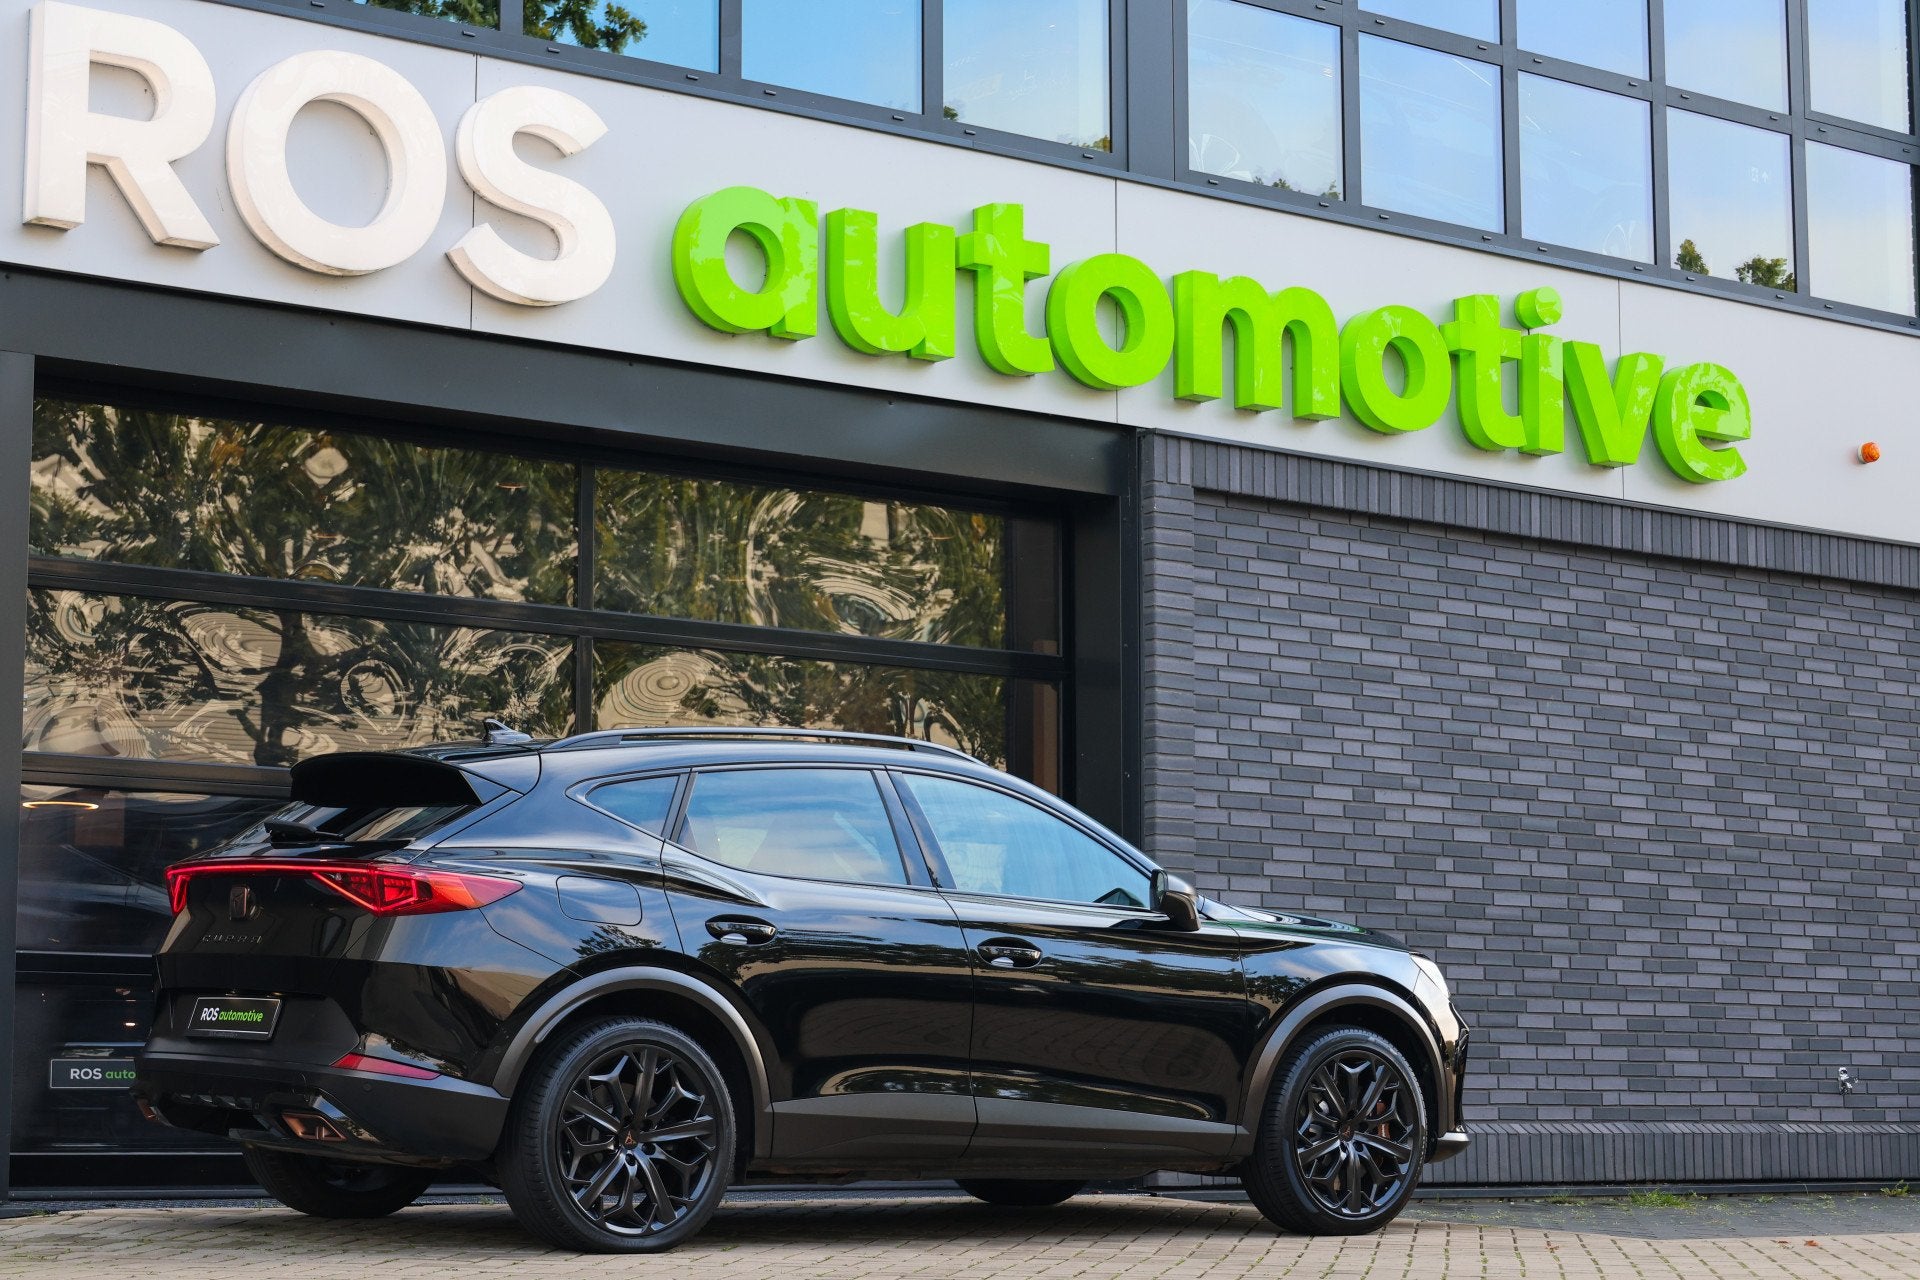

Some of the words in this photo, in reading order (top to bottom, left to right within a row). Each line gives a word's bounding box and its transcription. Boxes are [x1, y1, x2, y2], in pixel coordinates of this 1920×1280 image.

[22, 0, 617, 307] ROS
[671, 186, 1752, 484] automotive
[200, 1007, 220, 1021] ROS
[218, 1009, 264, 1022] automotive
[70, 1068, 102, 1079] ROS
